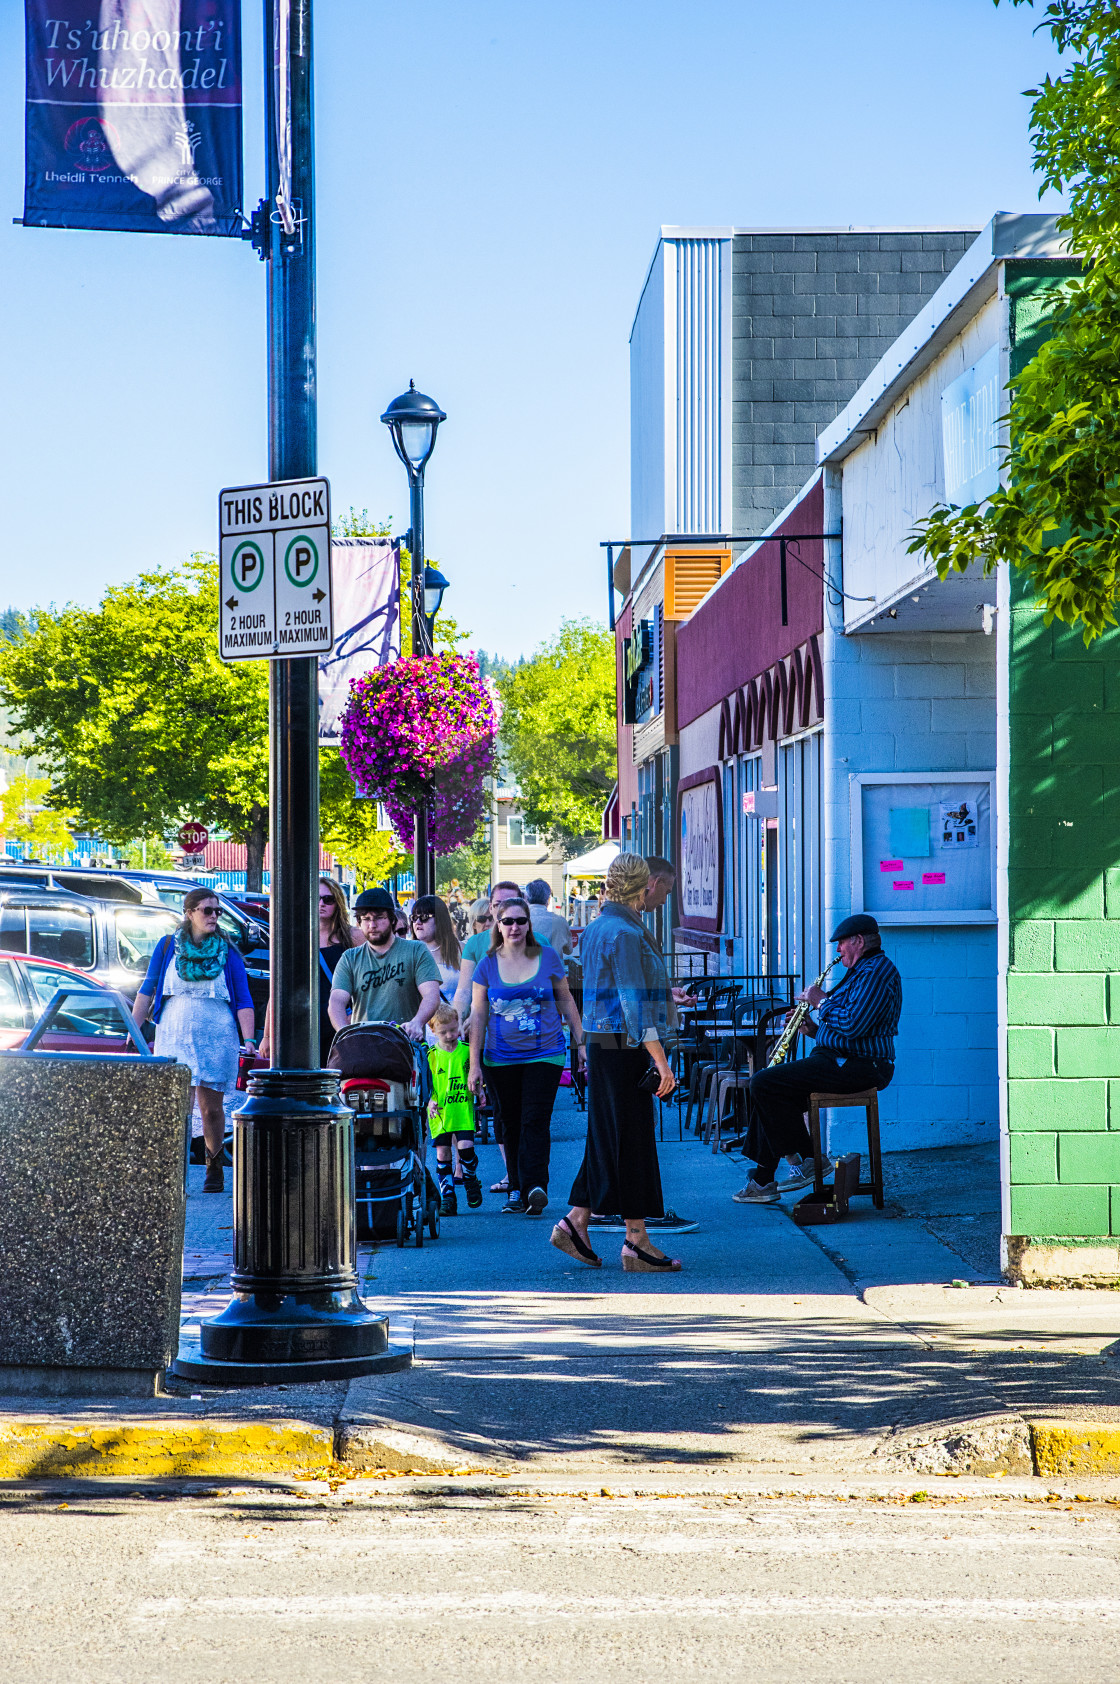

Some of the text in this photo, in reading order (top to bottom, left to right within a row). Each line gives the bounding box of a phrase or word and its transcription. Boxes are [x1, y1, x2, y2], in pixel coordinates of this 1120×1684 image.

[45, 57, 227, 89] Whuzhadel
[45, 170, 139, 184] Lheidli T'enneh
[152, 176, 223, 186] PRINCE GEORGE
[943, 374, 999, 498] SHOE REPAI
[224, 489, 324, 526] THIS BLOCK
[241, 553, 257, 582] P
[295, 547, 311, 577] P
[230, 614, 266, 630] 2 HOUR
[285, 609, 321, 626] 2 HOUR
[224, 630, 272, 648] MAXIMUM
[279, 626, 328, 644] MAXIMUM
[180, 831, 207, 844] STOP
[361, 961, 406, 992] Fallen
[448, 1075, 467, 1091] Tim
